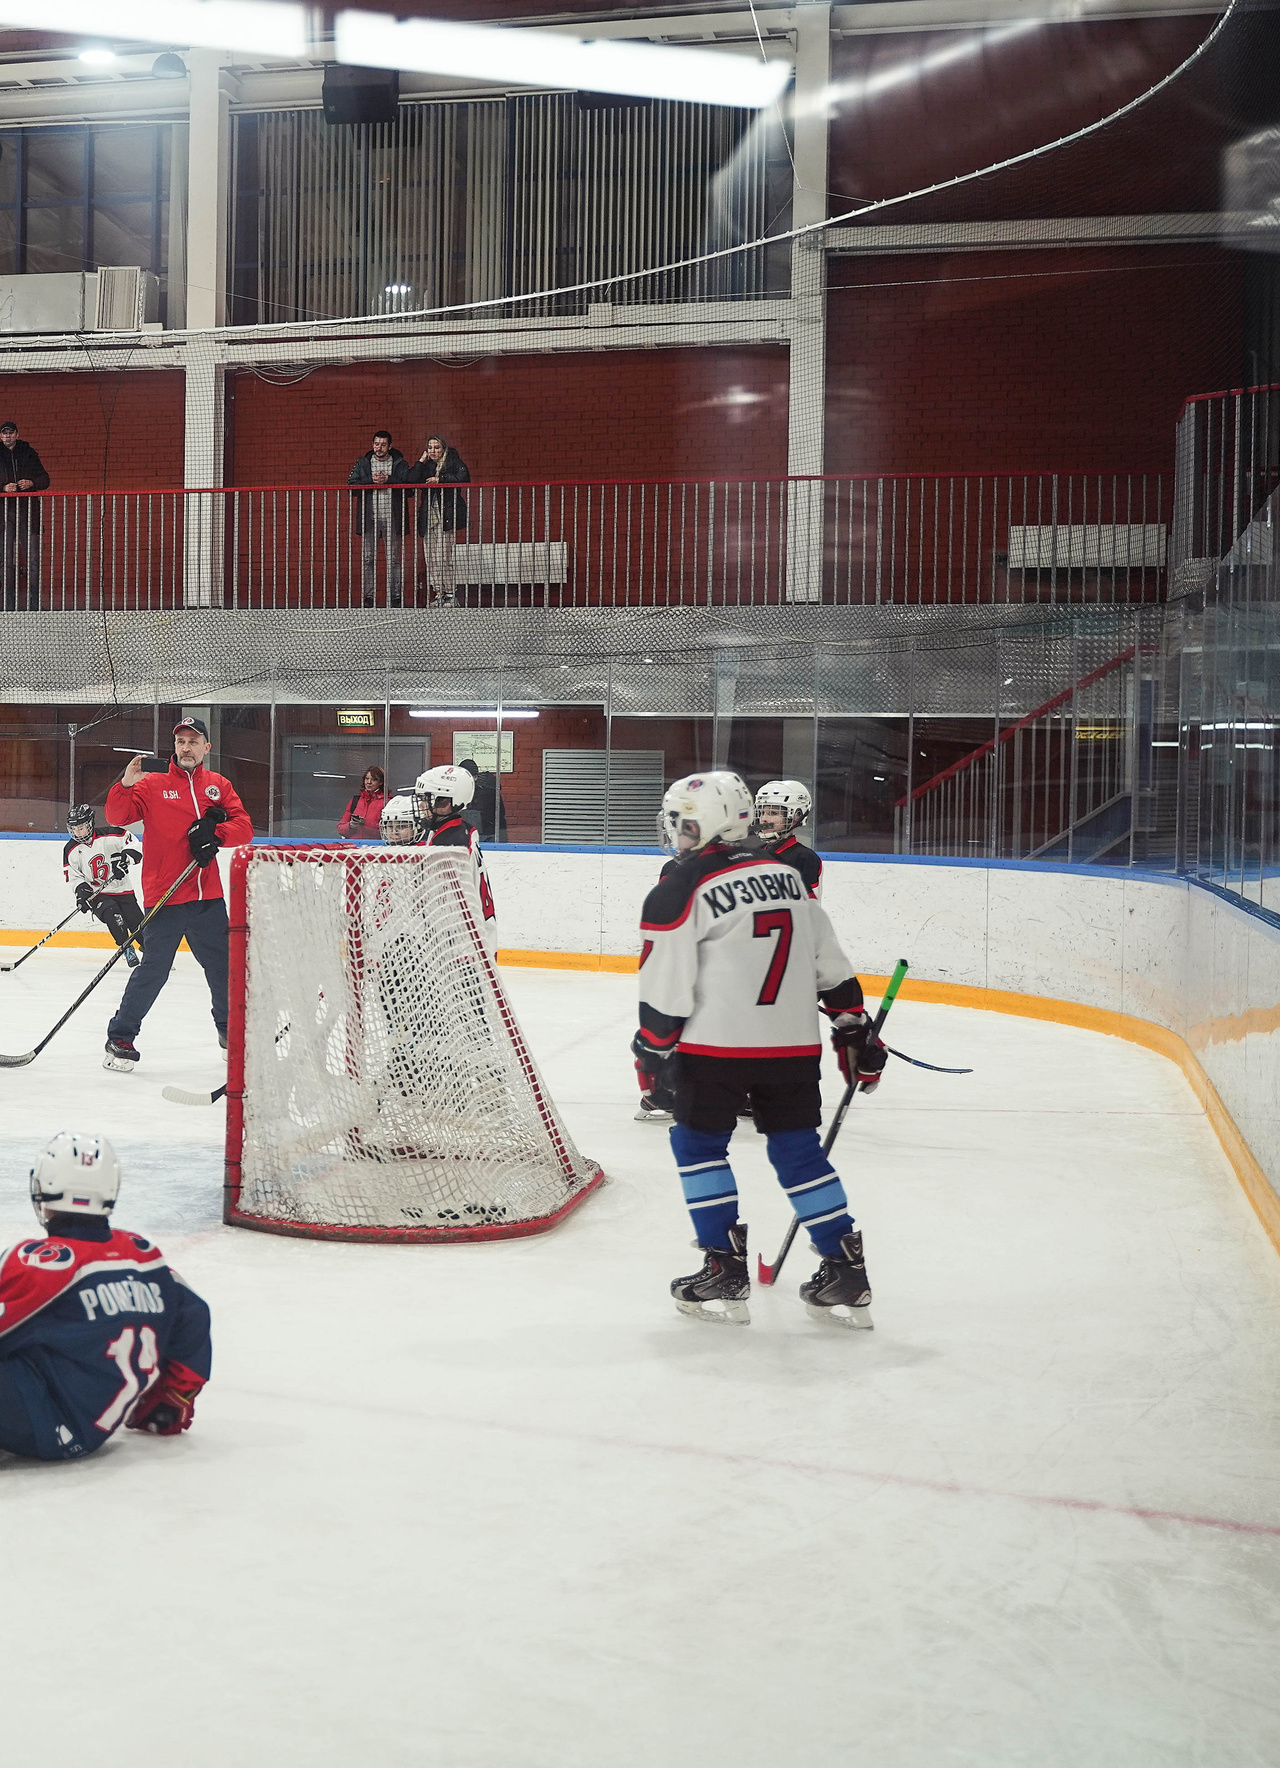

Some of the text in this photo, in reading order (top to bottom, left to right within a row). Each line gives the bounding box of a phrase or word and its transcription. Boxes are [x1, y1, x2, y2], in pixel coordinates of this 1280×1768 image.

[340, 714, 370, 726] ВЫХОД
[702, 873, 802, 919] КУЗОВКО
[752, 908, 794, 1006] 7
[81, 1152, 94, 1166] 13
